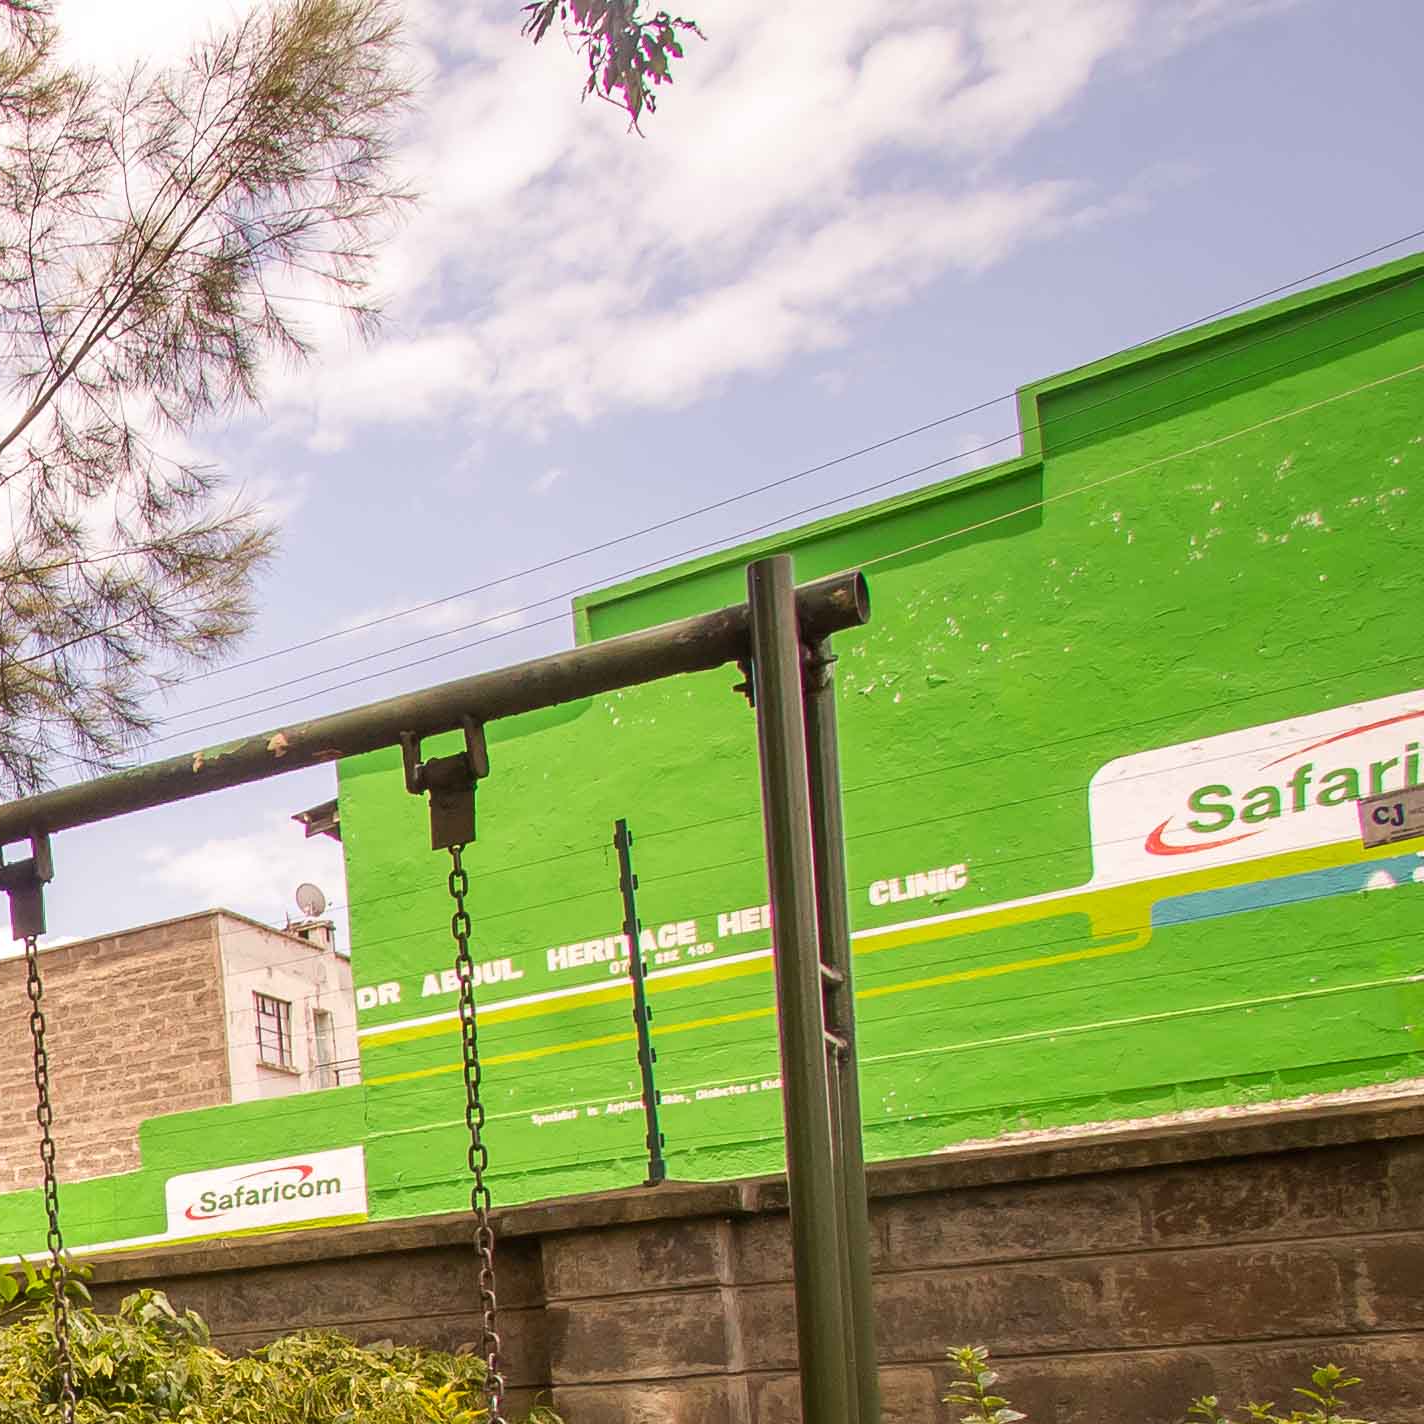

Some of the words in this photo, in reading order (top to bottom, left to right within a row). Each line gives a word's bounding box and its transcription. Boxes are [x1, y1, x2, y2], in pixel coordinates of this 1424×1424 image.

[356, 981, 401, 1011] DR
[547, 919, 698, 972] HERITAGE
[869, 863, 968, 905] CLINIC
[200, 1176, 342, 1212] Safaricom
